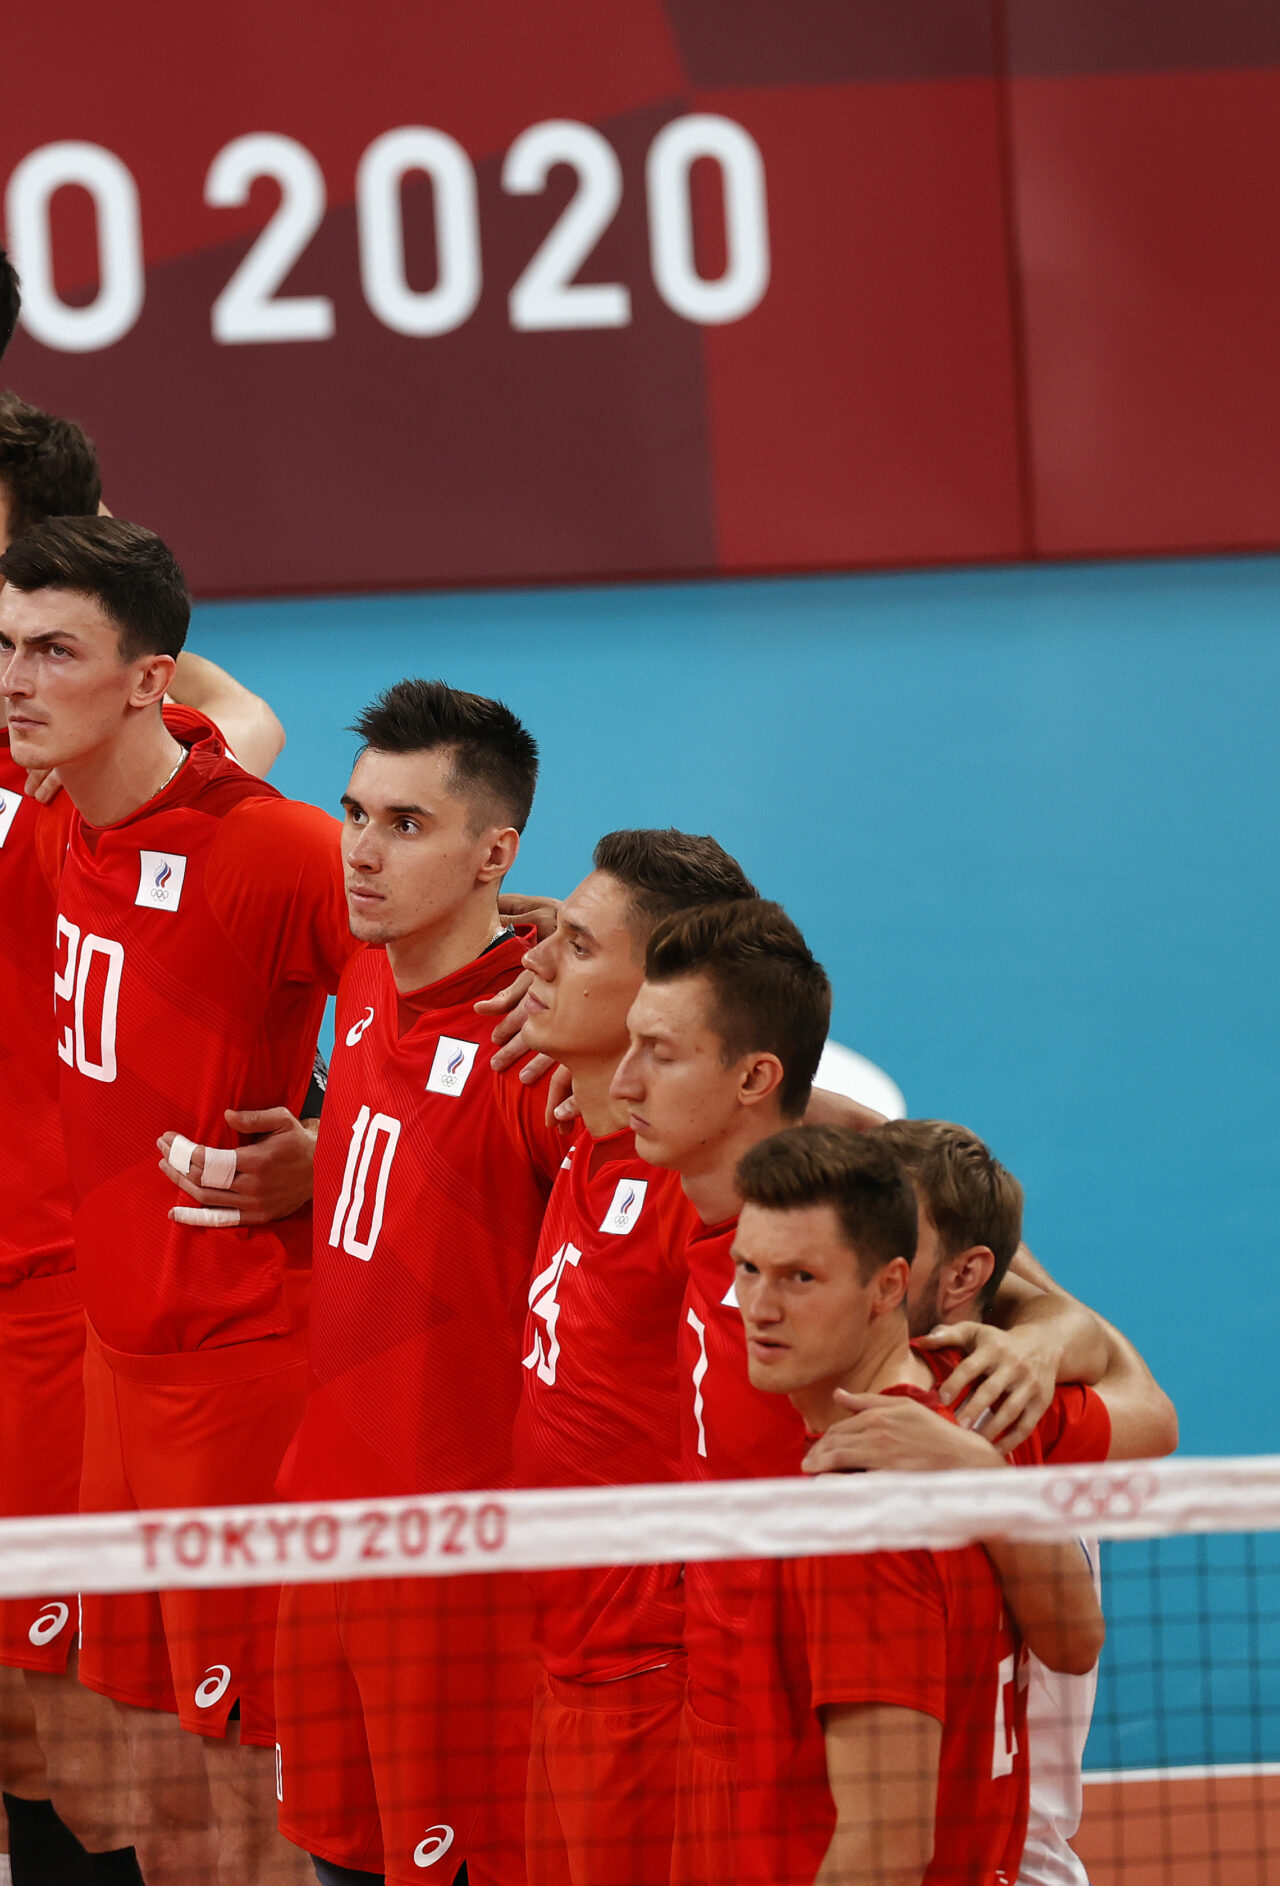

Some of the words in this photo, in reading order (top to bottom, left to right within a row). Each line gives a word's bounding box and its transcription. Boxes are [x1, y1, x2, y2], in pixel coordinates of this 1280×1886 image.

[204, 113, 771, 345] 2020
[53, 912, 125, 1083] 20
[328, 1104, 402, 1262] 10
[520, 1241, 583, 1387] 15
[138, 1514, 341, 1570] TOKYO
[358, 1503, 507, 1560] 2020
